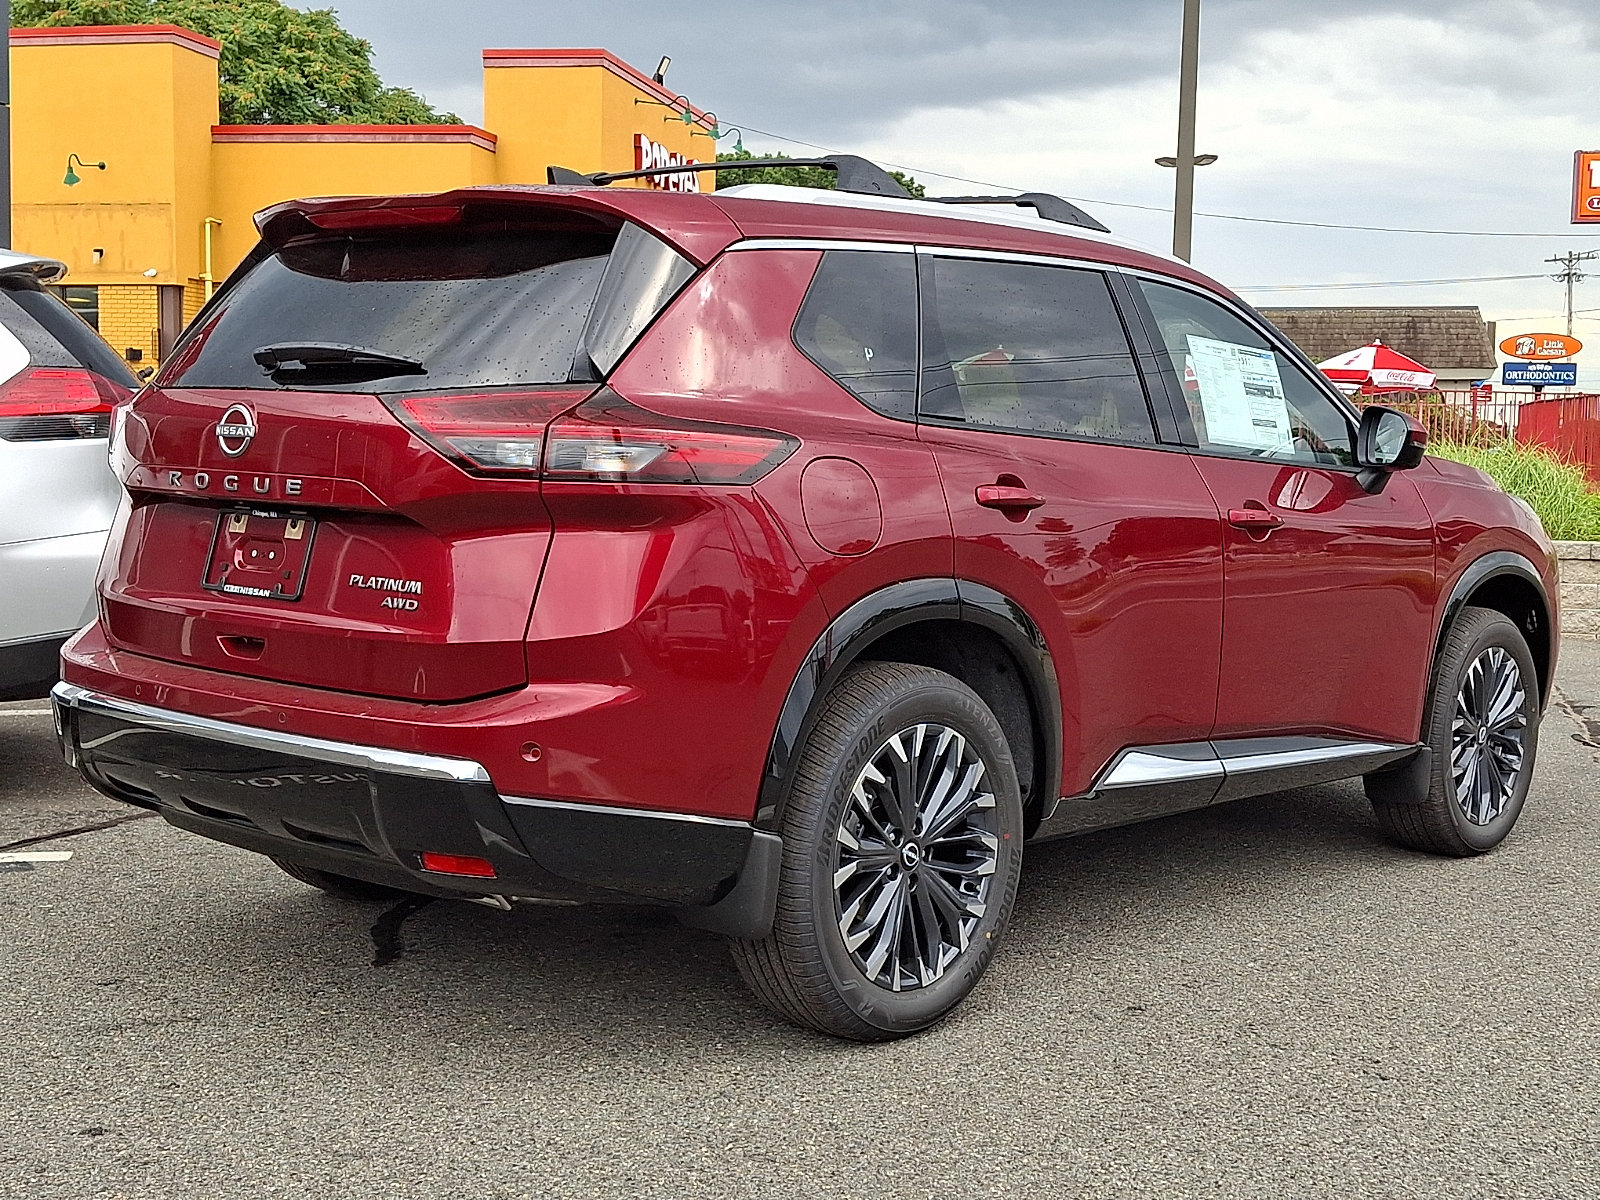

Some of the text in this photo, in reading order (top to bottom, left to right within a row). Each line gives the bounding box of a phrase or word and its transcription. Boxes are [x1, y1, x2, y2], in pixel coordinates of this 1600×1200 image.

[1505, 371, 1574, 380] ORTHODONTICS
[216, 423, 255, 438] NISSAN
[169, 470, 302, 495] ROGUE
[349, 574, 422, 595] PLATINUM
[380, 596, 419, 611] AWD
